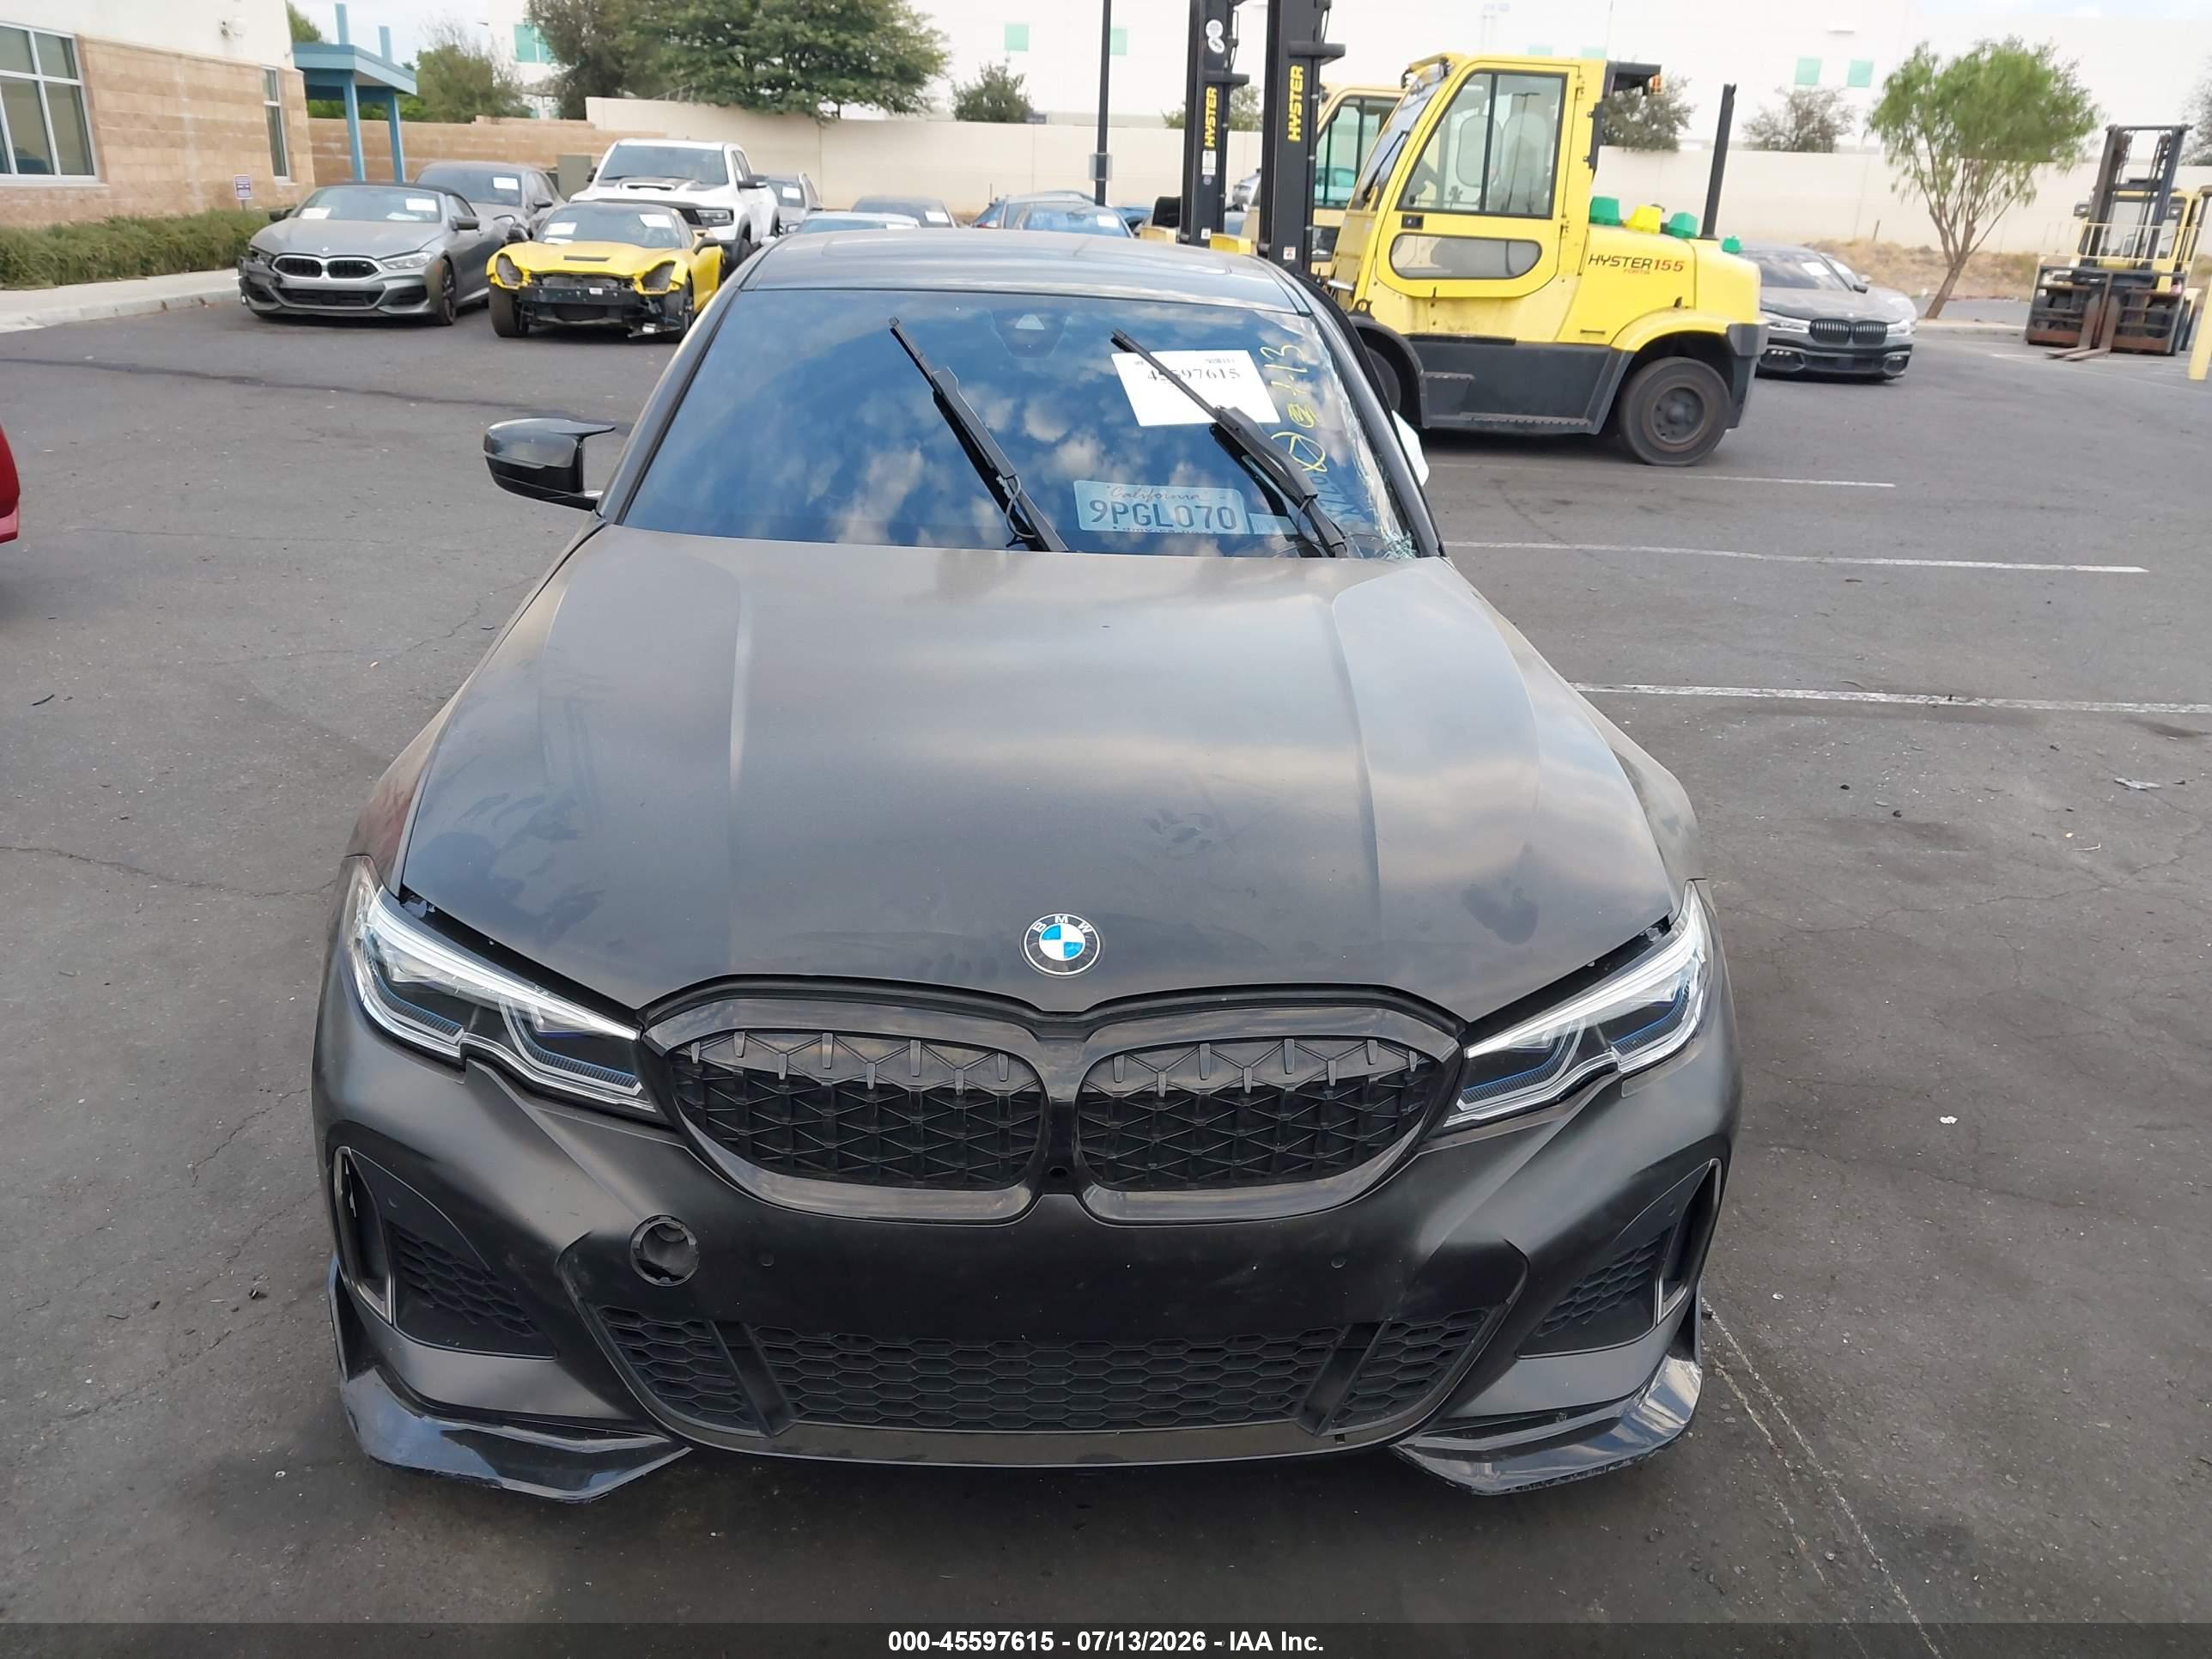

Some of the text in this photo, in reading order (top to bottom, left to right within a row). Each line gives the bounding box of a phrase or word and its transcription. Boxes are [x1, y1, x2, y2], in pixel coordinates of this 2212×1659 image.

[1287, 64, 1304, 142] HYSTER
[1204, 86, 1218, 148] HYSTER
[1588, 254, 1685, 272] HYSTER 155
[1147, 368, 1241, 381] 497615
[1109, 485, 1202, 503] California
[1089, 499, 1237, 531] 9PGL070
[1032, 915, 1093, 933] BMW
